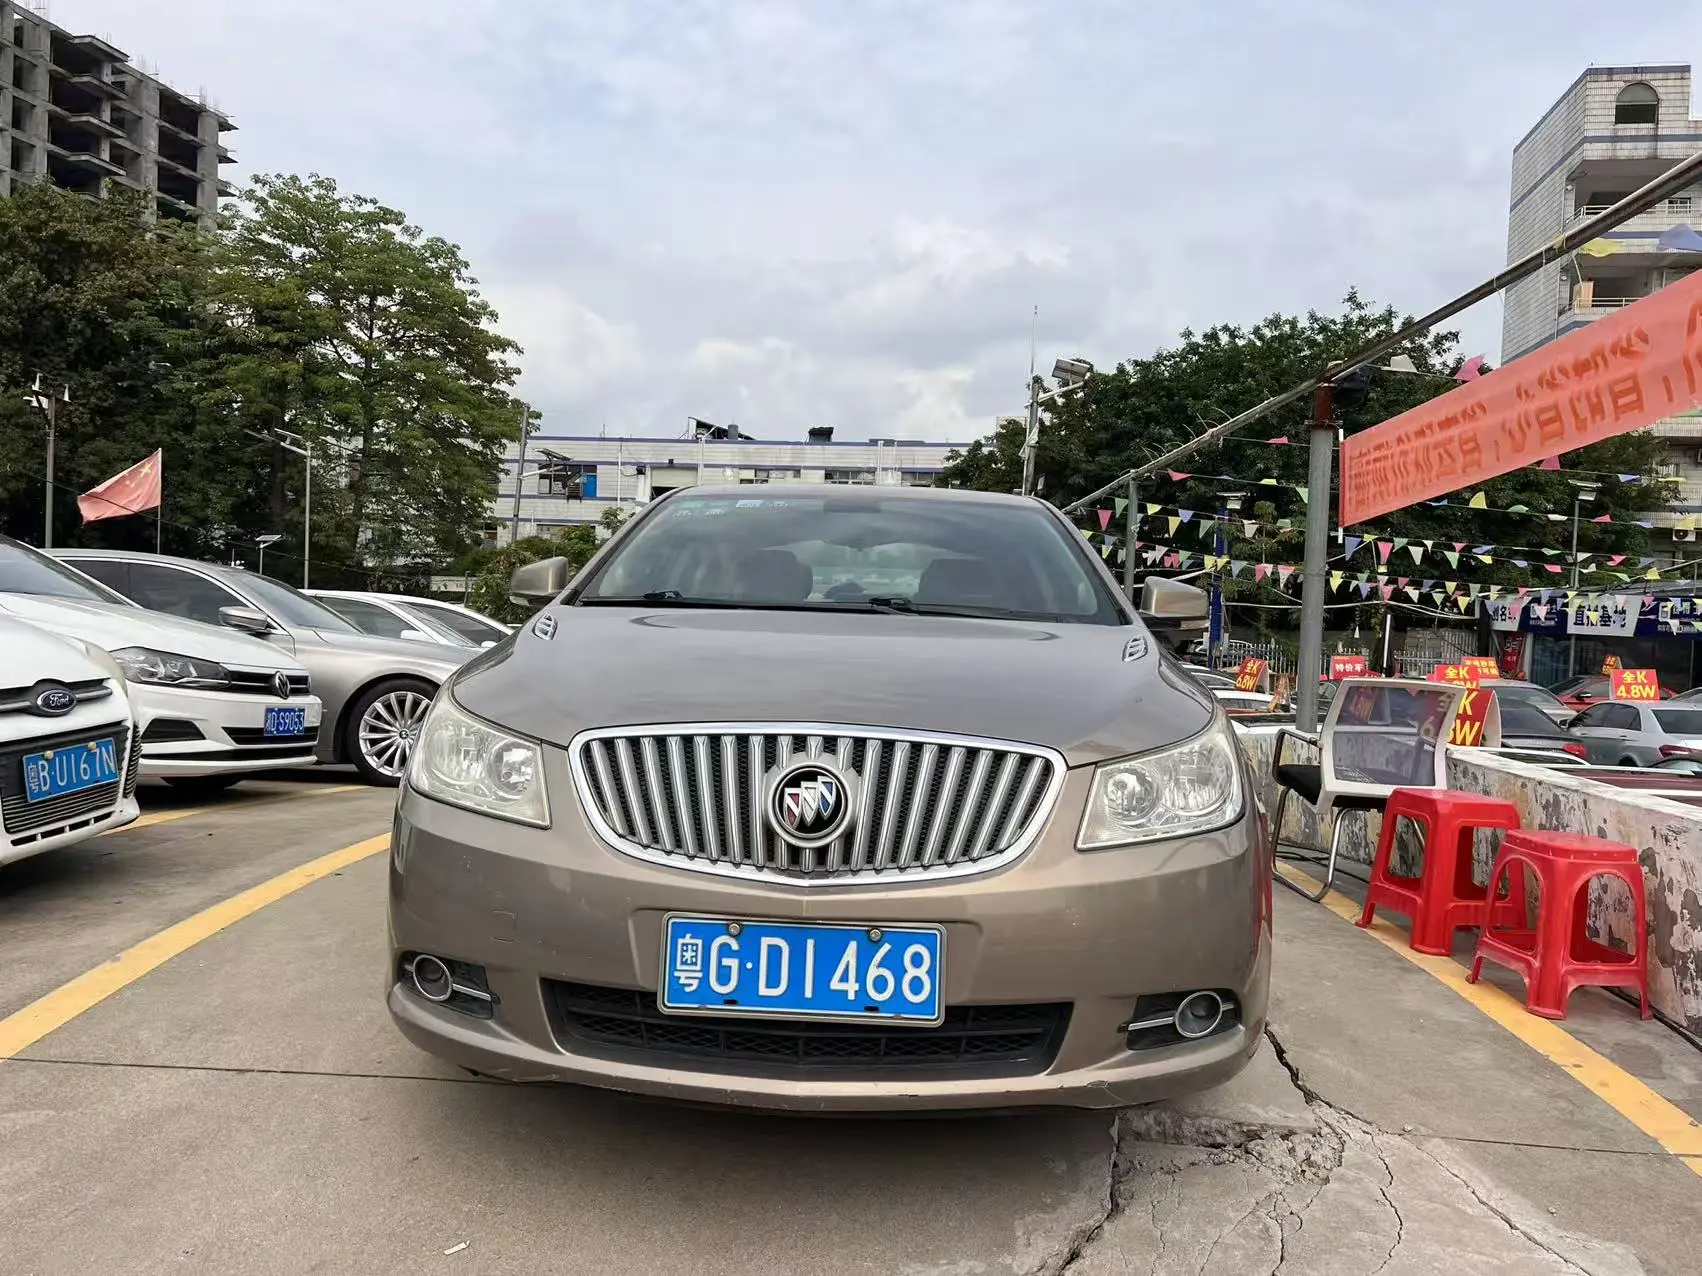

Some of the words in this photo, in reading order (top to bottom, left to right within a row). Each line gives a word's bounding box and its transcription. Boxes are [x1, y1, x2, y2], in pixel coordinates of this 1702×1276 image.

[1335, 663, 1363, 673] 特价车
[1445, 665, 1470, 679] 全K
[1622, 671, 1648, 683] 全K
[1616, 684, 1656, 699] 4.8W
[49, 693, 70, 707] Ford
[673, 933, 932, 1004] 粤G·D1468
